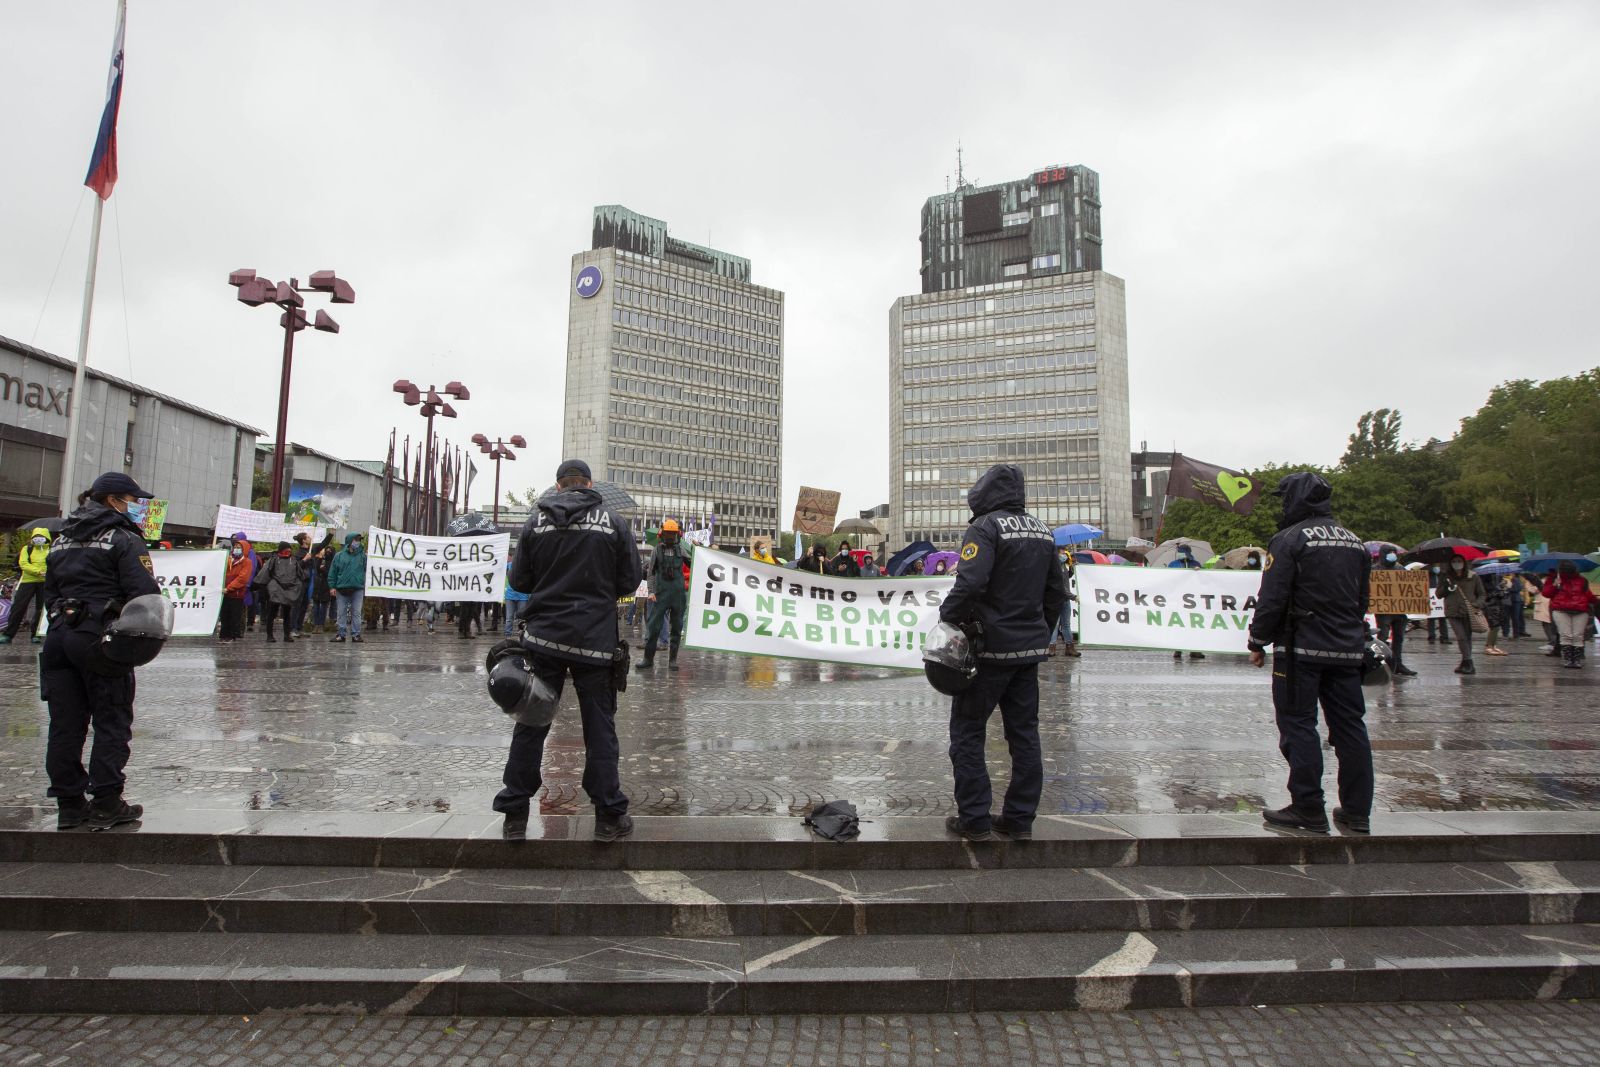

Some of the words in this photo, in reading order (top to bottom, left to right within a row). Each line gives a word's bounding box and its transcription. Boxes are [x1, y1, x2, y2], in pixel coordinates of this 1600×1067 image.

[0, 372, 73, 417] maxi
[997, 515, 1052, 535] POLICIJA
[374, 533, 416, 560] NVO
[443, 543, 498, 566] GLAS,
[371, 566, 431, 589] NARAVA
[415, 561, 425, 569] KI
[433, 562, 449, 571] GA
[156, 575, 206, 586] RABI
[707, 563, 857, 603] Gledamo
[877, 590, 950, 607] VAS
[1376, 584, 1392, 597] NI
[704, 582, 736, 608] in
[756, 594, 797, 618] NE
[816, 603, 918, 627] BOMO
[1094, 588, 1167, 608] Roke
[1182, 592, 1257, 611] STRA
[1096, 607, 1129, 624] od
[1146, 610, 1249, 630] NARAV
